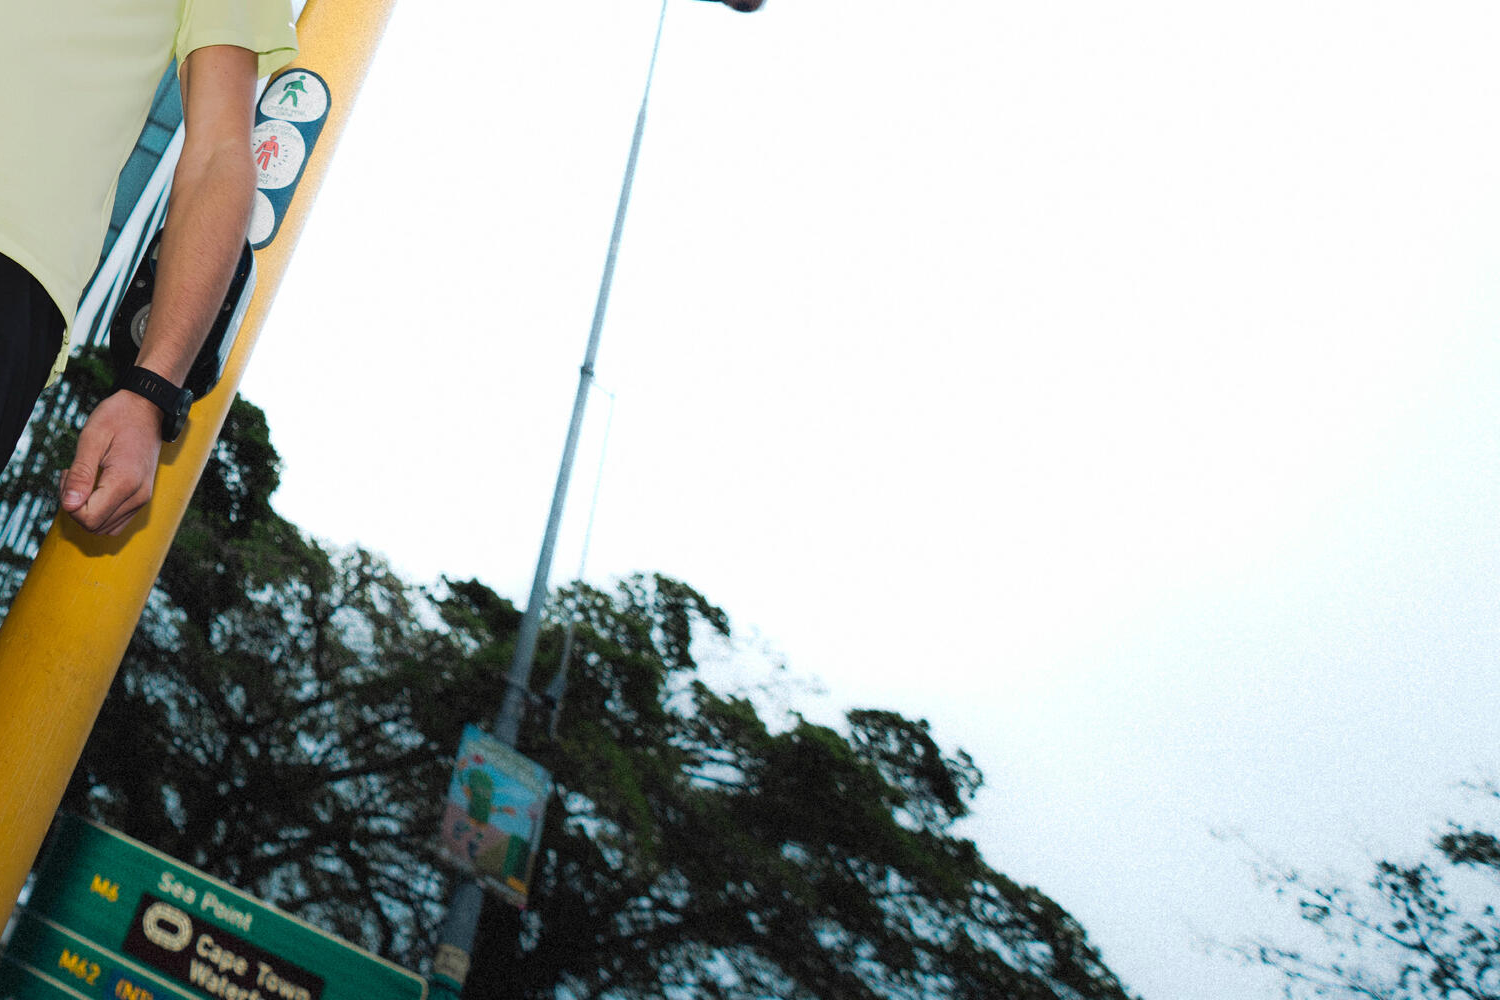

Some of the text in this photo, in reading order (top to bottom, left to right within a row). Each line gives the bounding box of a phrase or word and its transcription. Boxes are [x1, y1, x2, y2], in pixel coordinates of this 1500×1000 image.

[90, 873, 120, 903] M6
[157, 871, 253, 932] Sea Point
[58, 948, 101, 987] M62
[196, 933, 312, 1000] Cape Town
